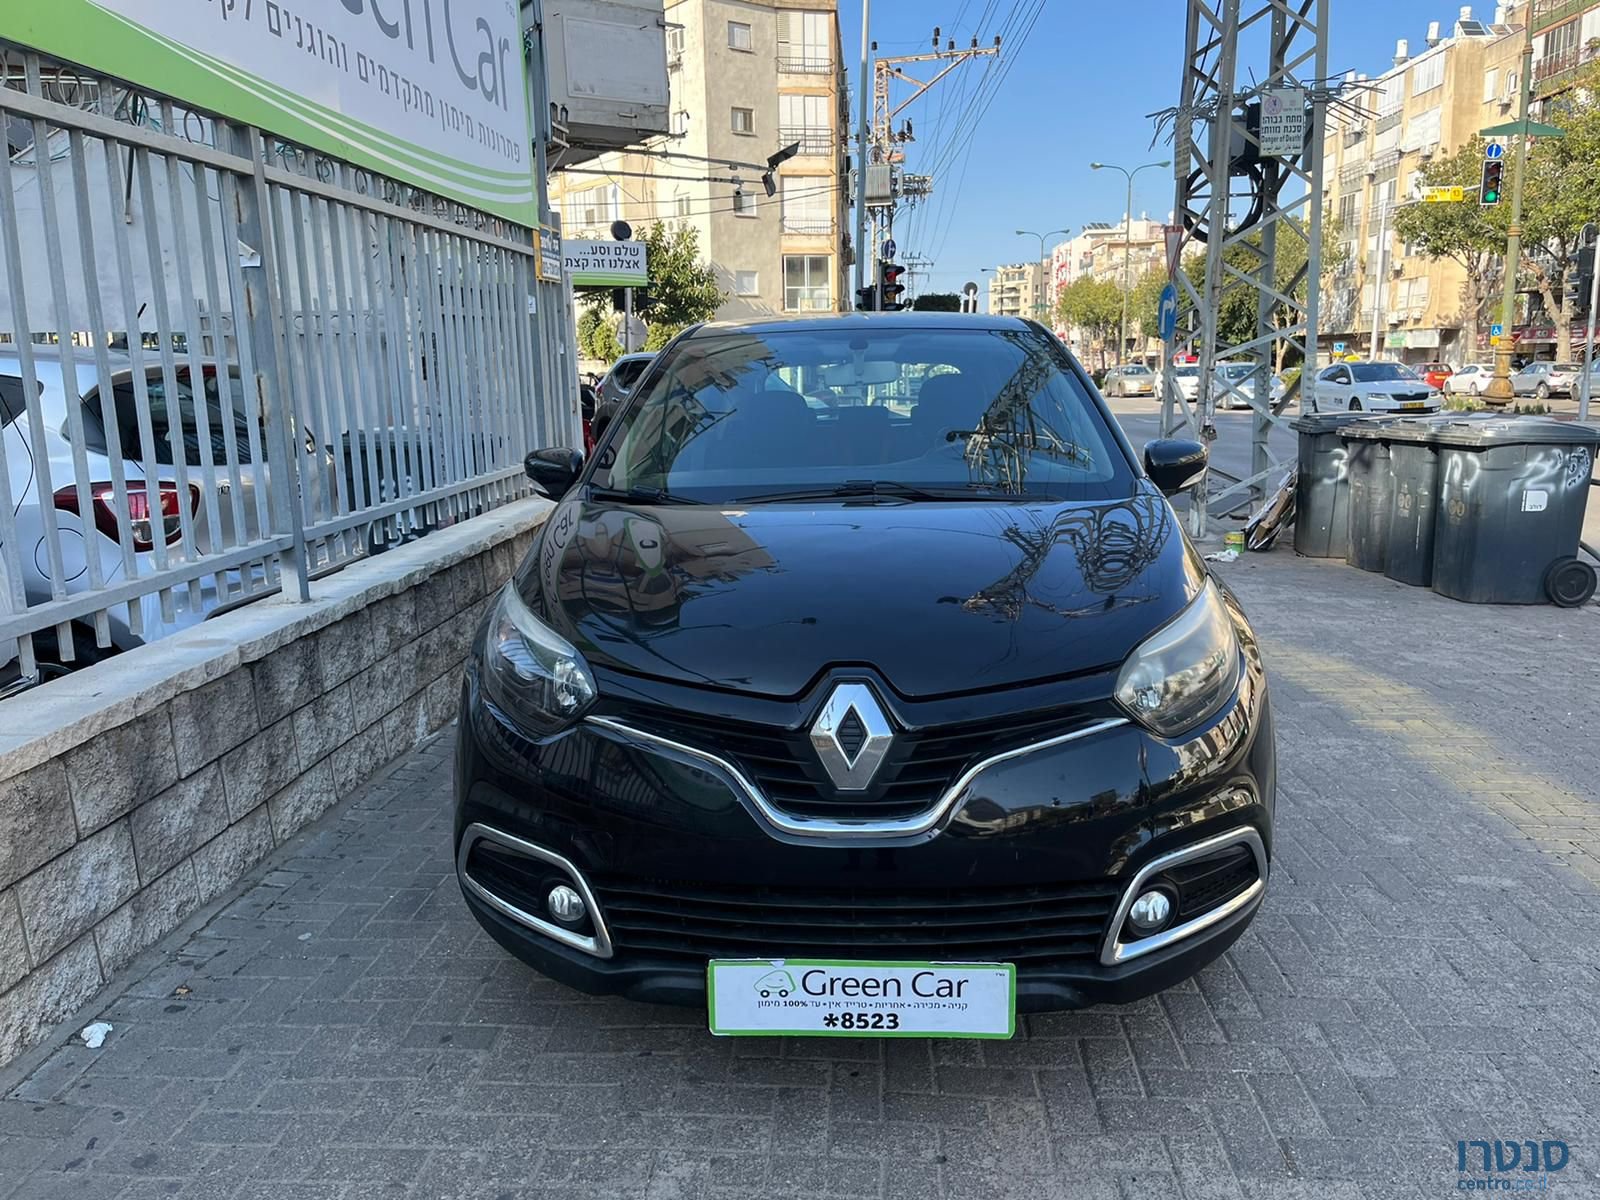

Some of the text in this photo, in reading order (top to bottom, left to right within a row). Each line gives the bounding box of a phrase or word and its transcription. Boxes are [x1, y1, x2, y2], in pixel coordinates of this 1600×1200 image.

[265, 0, 349, 73] והוגנים
[356, 51, 435, 118] מתקדמים
[439, 99, 474, 139] מימון
[1285, 115, 1302, 123] מתח
[478, 121, 520, 163] פתרונות
[1261, 135, 1279, 144] Danger
[579, 245, 639, 256] שלם וסע...
[564, 257, 589, 270] קצת
[592, 258, 605, 269] זה
[609, 258, 640, 269] אצלנו
[801, 969, 969, 998] Green Car
[757, 1000, 780, 1008] מימון
[783, 1000, 808, 1008] 100%
[811, 1000, 821, 1008] עד
[828, 1000, 841, 1009] אין
[844, 1001, 868, 1009] טרייד
[874, 1001, 906, 1009] אחריות
[947, 1002, 968, 1011] קניה
